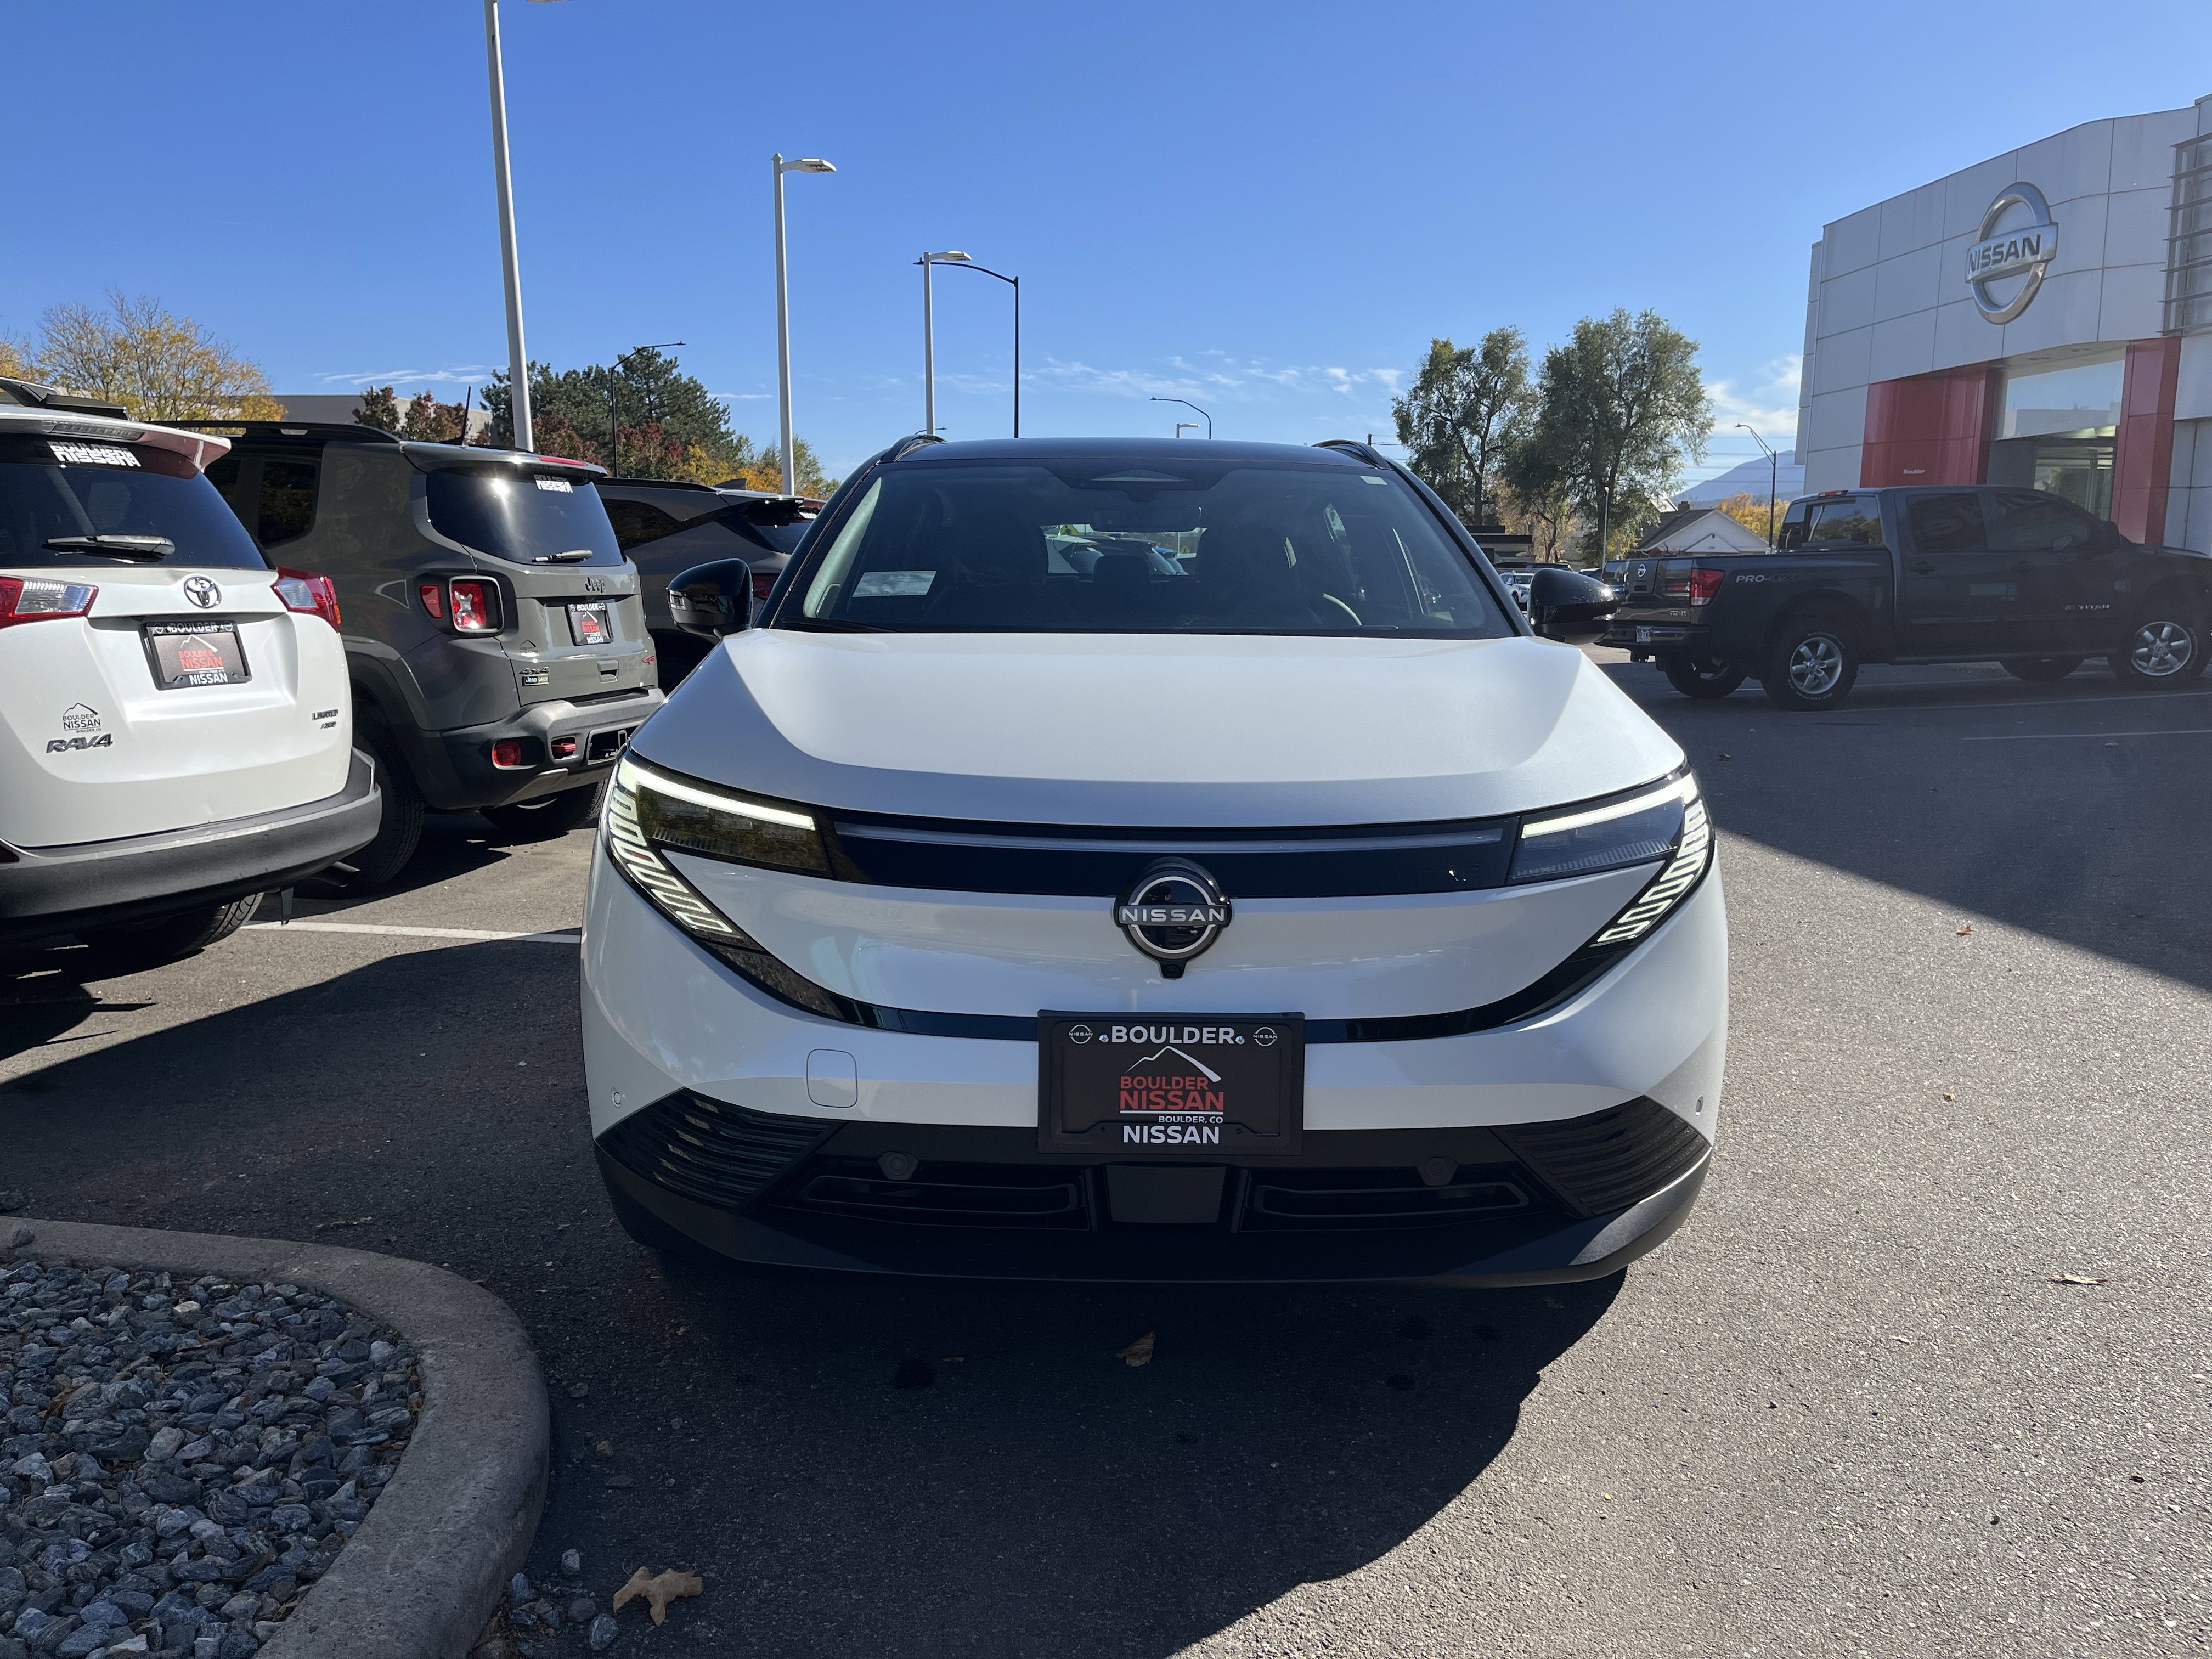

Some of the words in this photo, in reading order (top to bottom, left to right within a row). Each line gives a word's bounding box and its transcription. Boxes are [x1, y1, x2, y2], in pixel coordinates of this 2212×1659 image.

[1968, 233, 2041, 275] NISSAN
[1736, 573, 1797, 583] PRO-4X
[585, 577, 606, 593] Jeep
[577, 603, 599, 611] BOULDER
[170, 622, 218, 633] BOULDER
[178, 650, 214, 658] BOULDER
[180, 657, 224, 668] NISSAN
[189, 673, 228, 685] NISSAN
[63, 713, 94, 721] BOULDER
[63, 719, 100, 729] NISSAN
[46, 733, 113, 753] RAV4
[1122, 909, 1224, 922] NISSAN
[1111, 1026, 1235, 1044] BOULDER
[1120, 1076, 1209, 1090] BOULDER
[1120, 1090, 1224, 1111] NISSAN
[1158, 1115, 1207, 1124] BOULDER,
[1123, 1125, 1219, 1144] NISSAN
